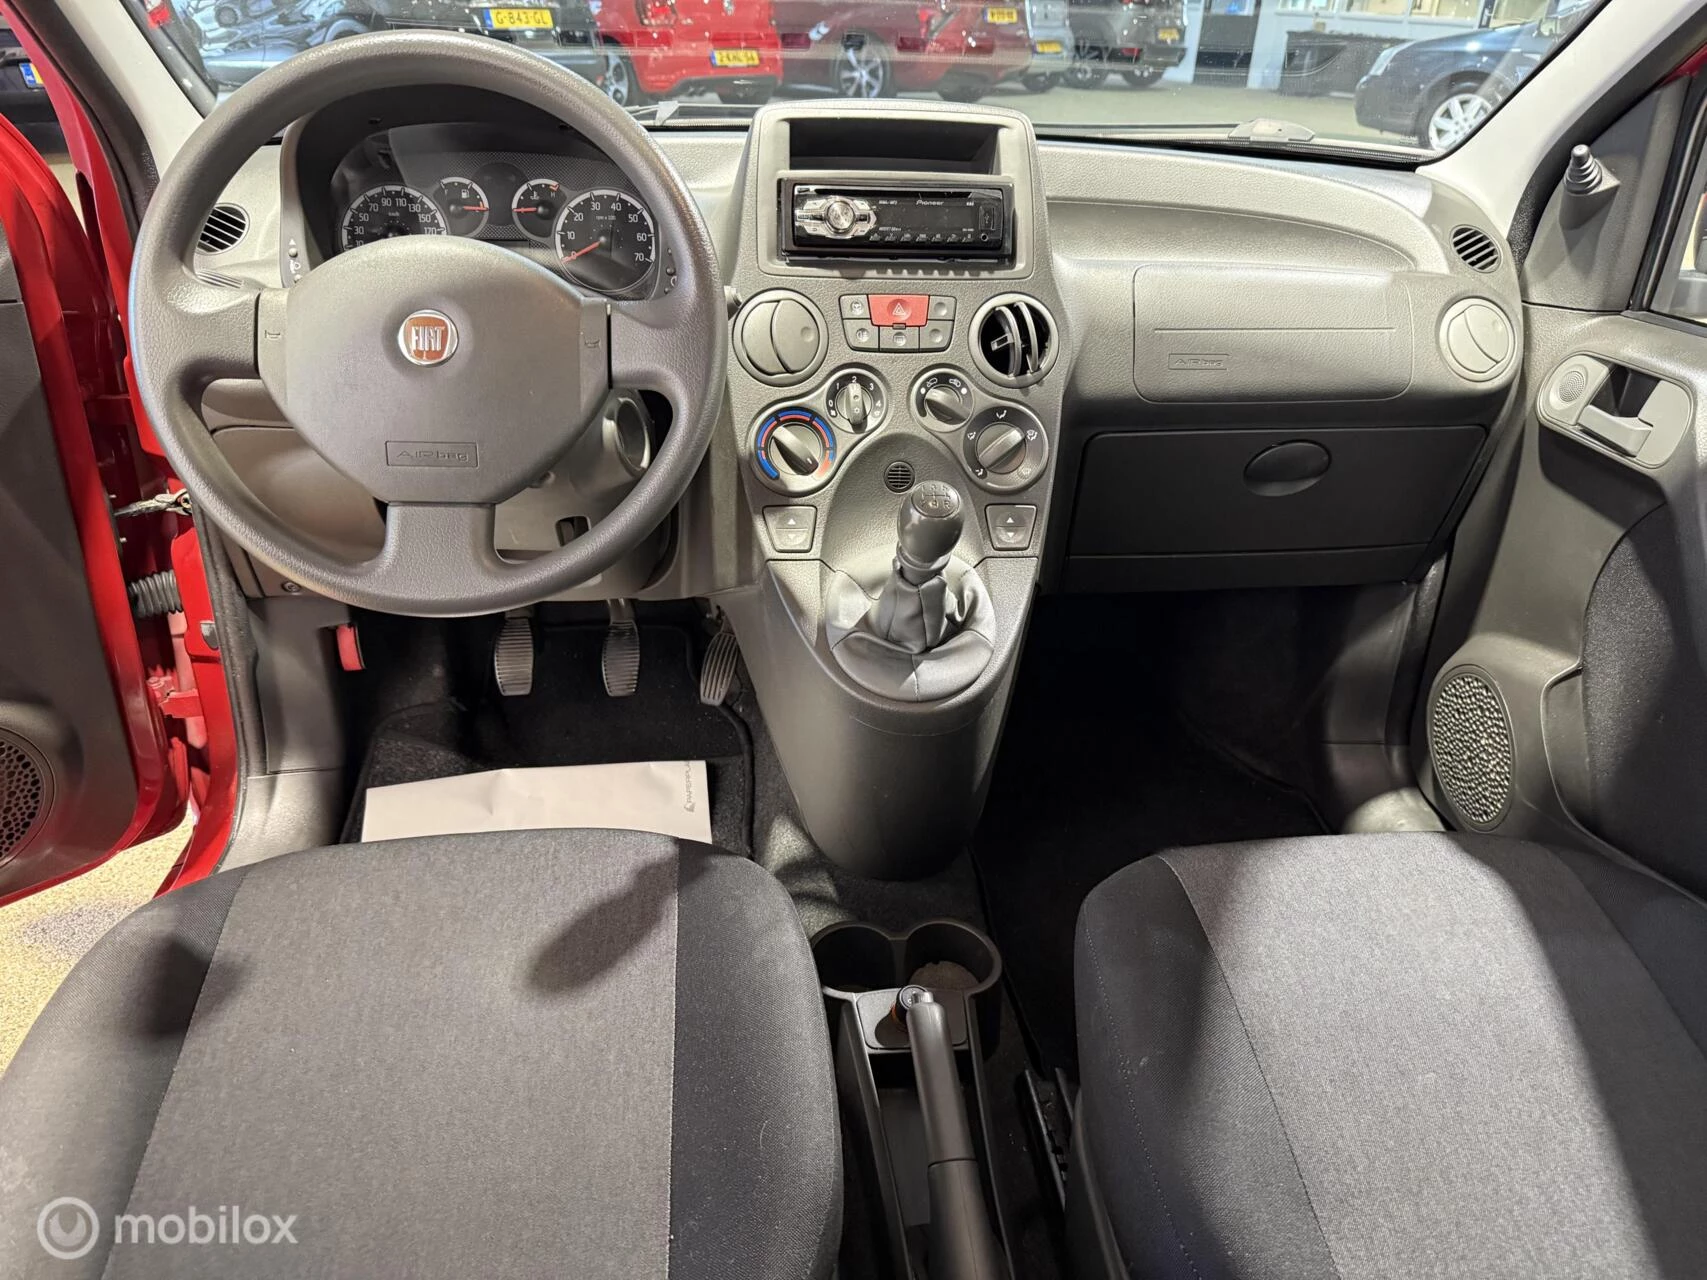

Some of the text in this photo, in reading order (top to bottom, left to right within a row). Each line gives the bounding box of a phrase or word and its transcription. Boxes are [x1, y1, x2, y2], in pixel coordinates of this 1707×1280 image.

[495, 11, 549, 25] G-843-GL
[381, 198, 392, 207] 90
[395, 198, 407, 207] 110
[590, 202, 601, 211] 30
[610, 202, 622, 212] 40
[368, 203, 379, 212] 70
[408, 203, 421, 212] 130
[359, 213, 369, 222] 50
[418, 213, 431, 223] 150
[573, 212, 584, 222] 20
[628, 213, 639, 223] 50
[354, 226, 364, 235] 30
[424, 227, 437, 235] 170
[567, 231, 576, 240] 10
[636, 232, 647, 242] 60
[634, 252, 645, 262] 70
[411, 326, 446, 351] FIAT
[852, 375, 858, 383] 2
[836, 382, 840, 390] 1
[869, 382, 875, 391] 3
[828, 400, 834, 408] 0
[875, 400, 882, 408] 4
